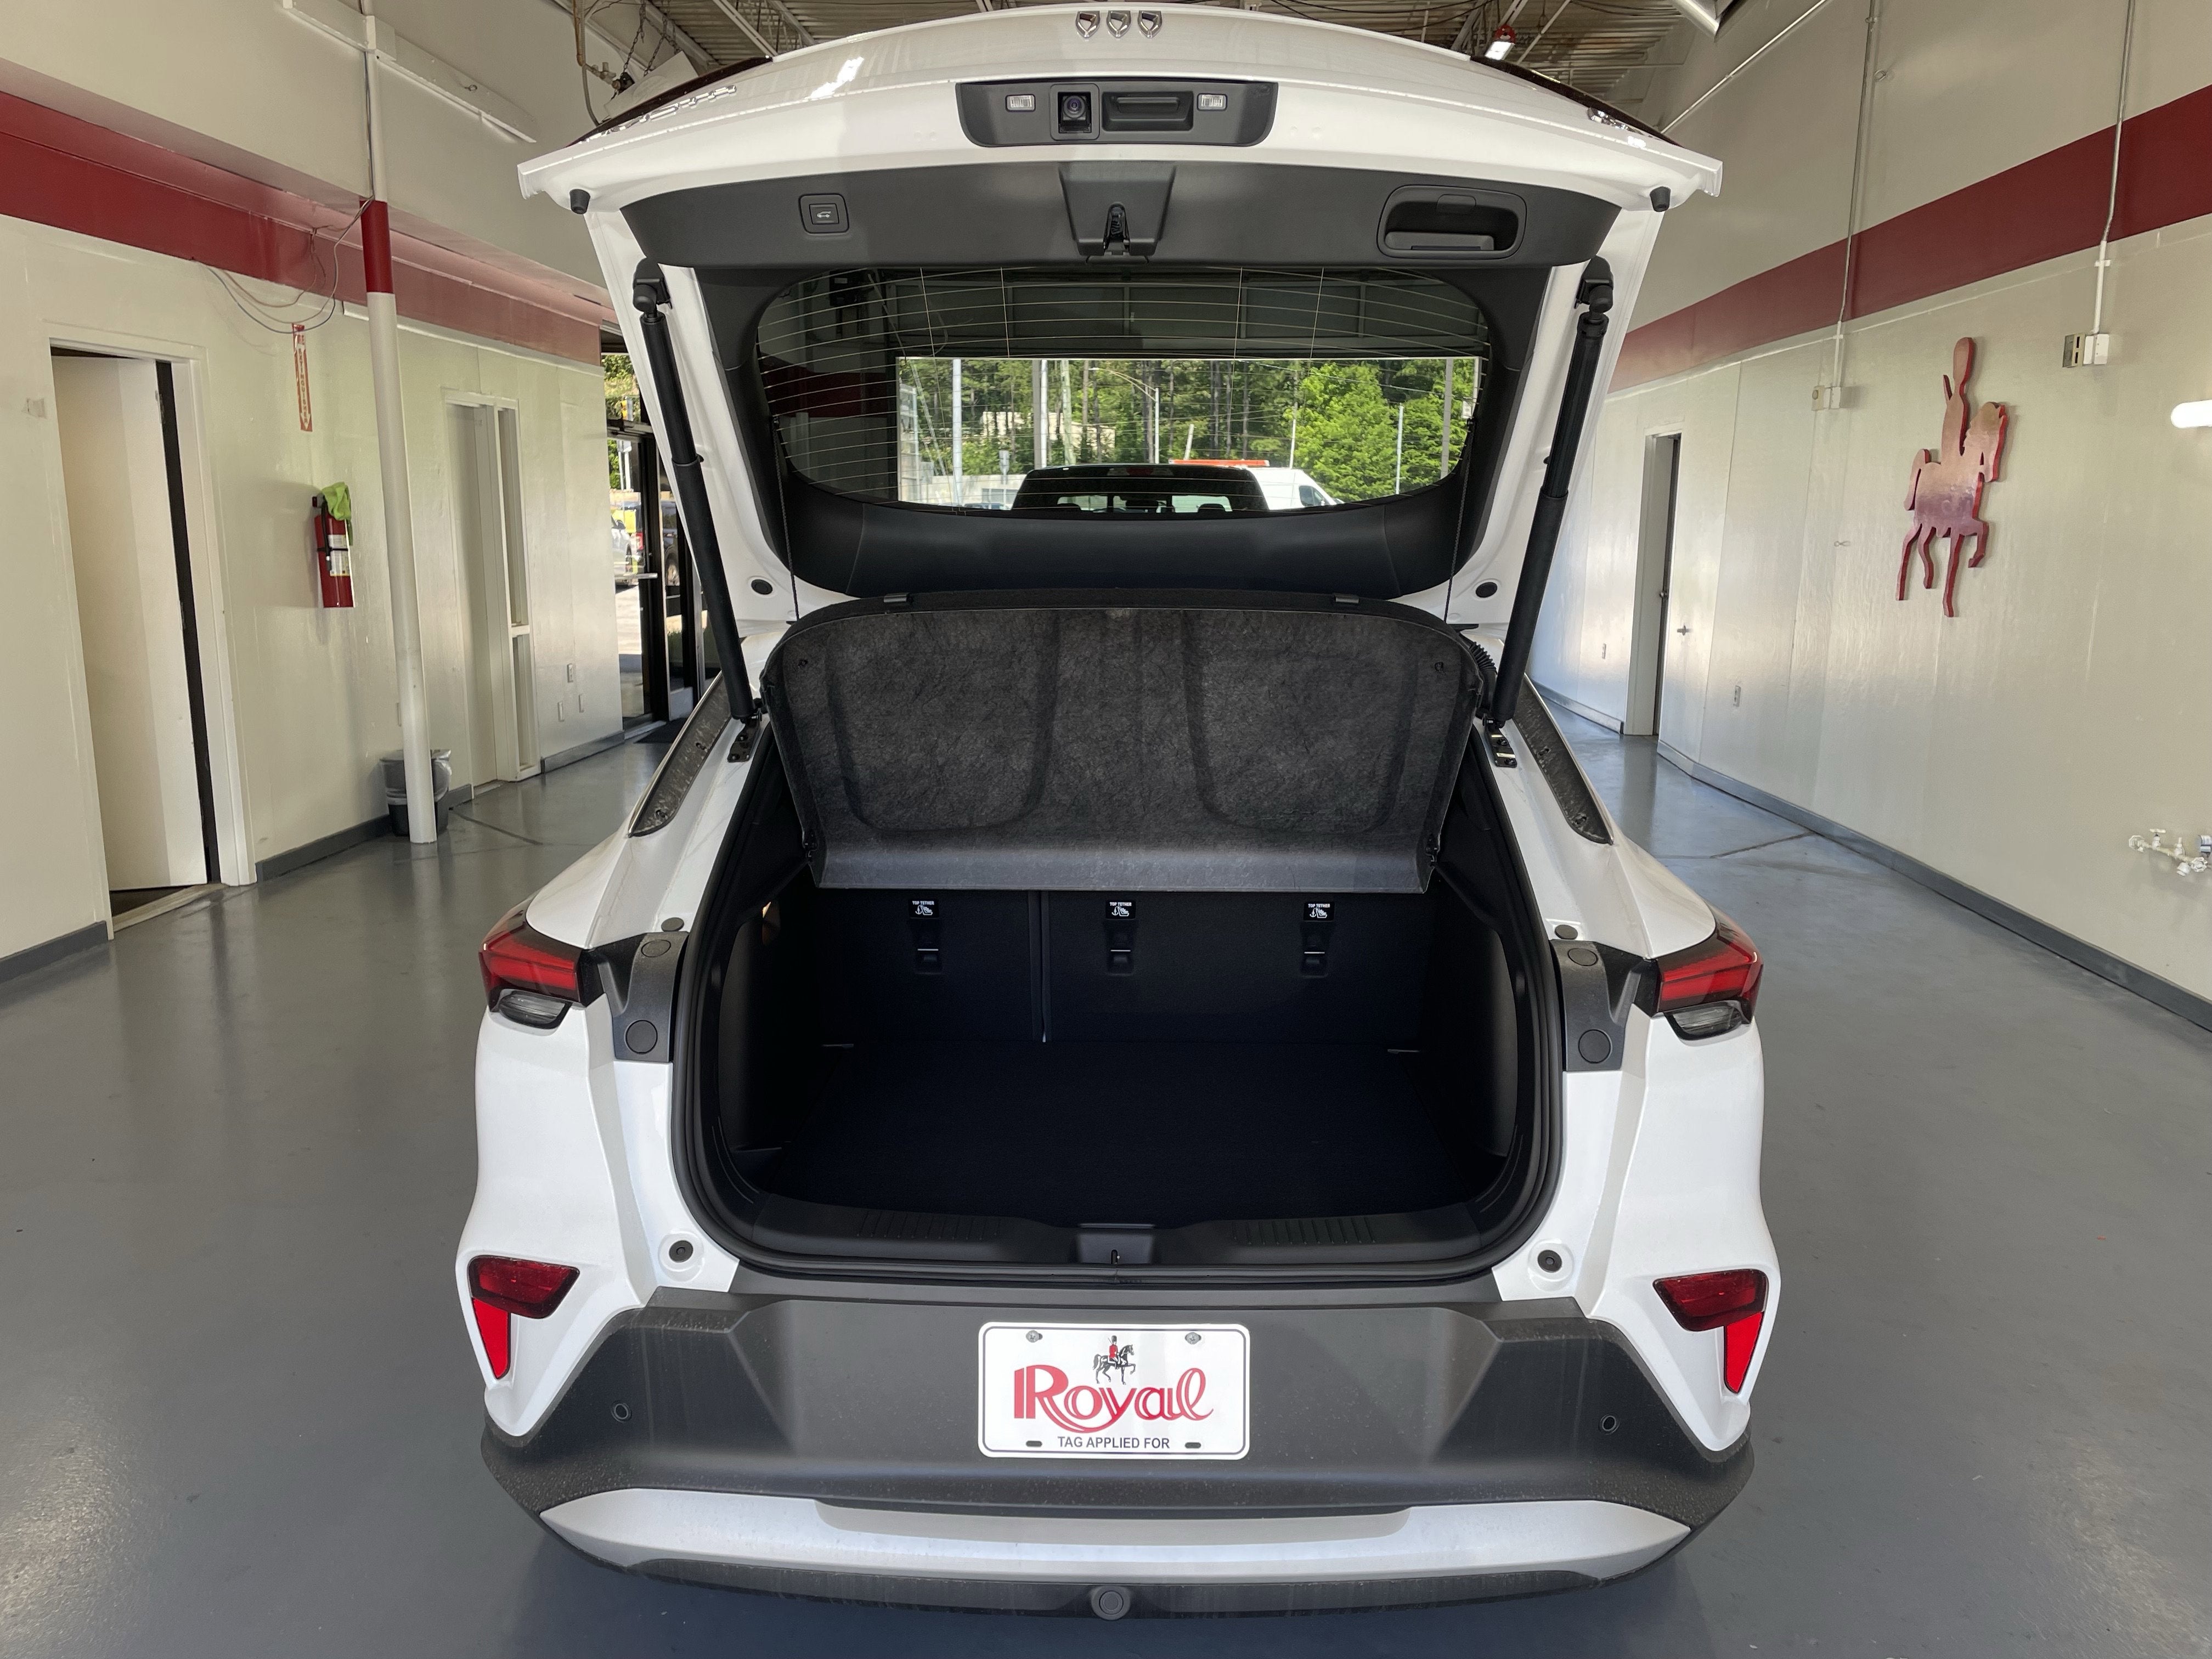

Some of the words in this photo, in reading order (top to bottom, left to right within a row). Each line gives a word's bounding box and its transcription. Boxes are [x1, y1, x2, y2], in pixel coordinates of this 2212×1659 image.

[298, 348, 308, 424] EXTINGUISHER
[1014, 1364, 1214, 1434] Royal
[1057, 1436, 1083, 1448] TAG
[1086, 1436, 1140, 1448] APPLIED
[1144, 1437, 1170, 1449] FOR
